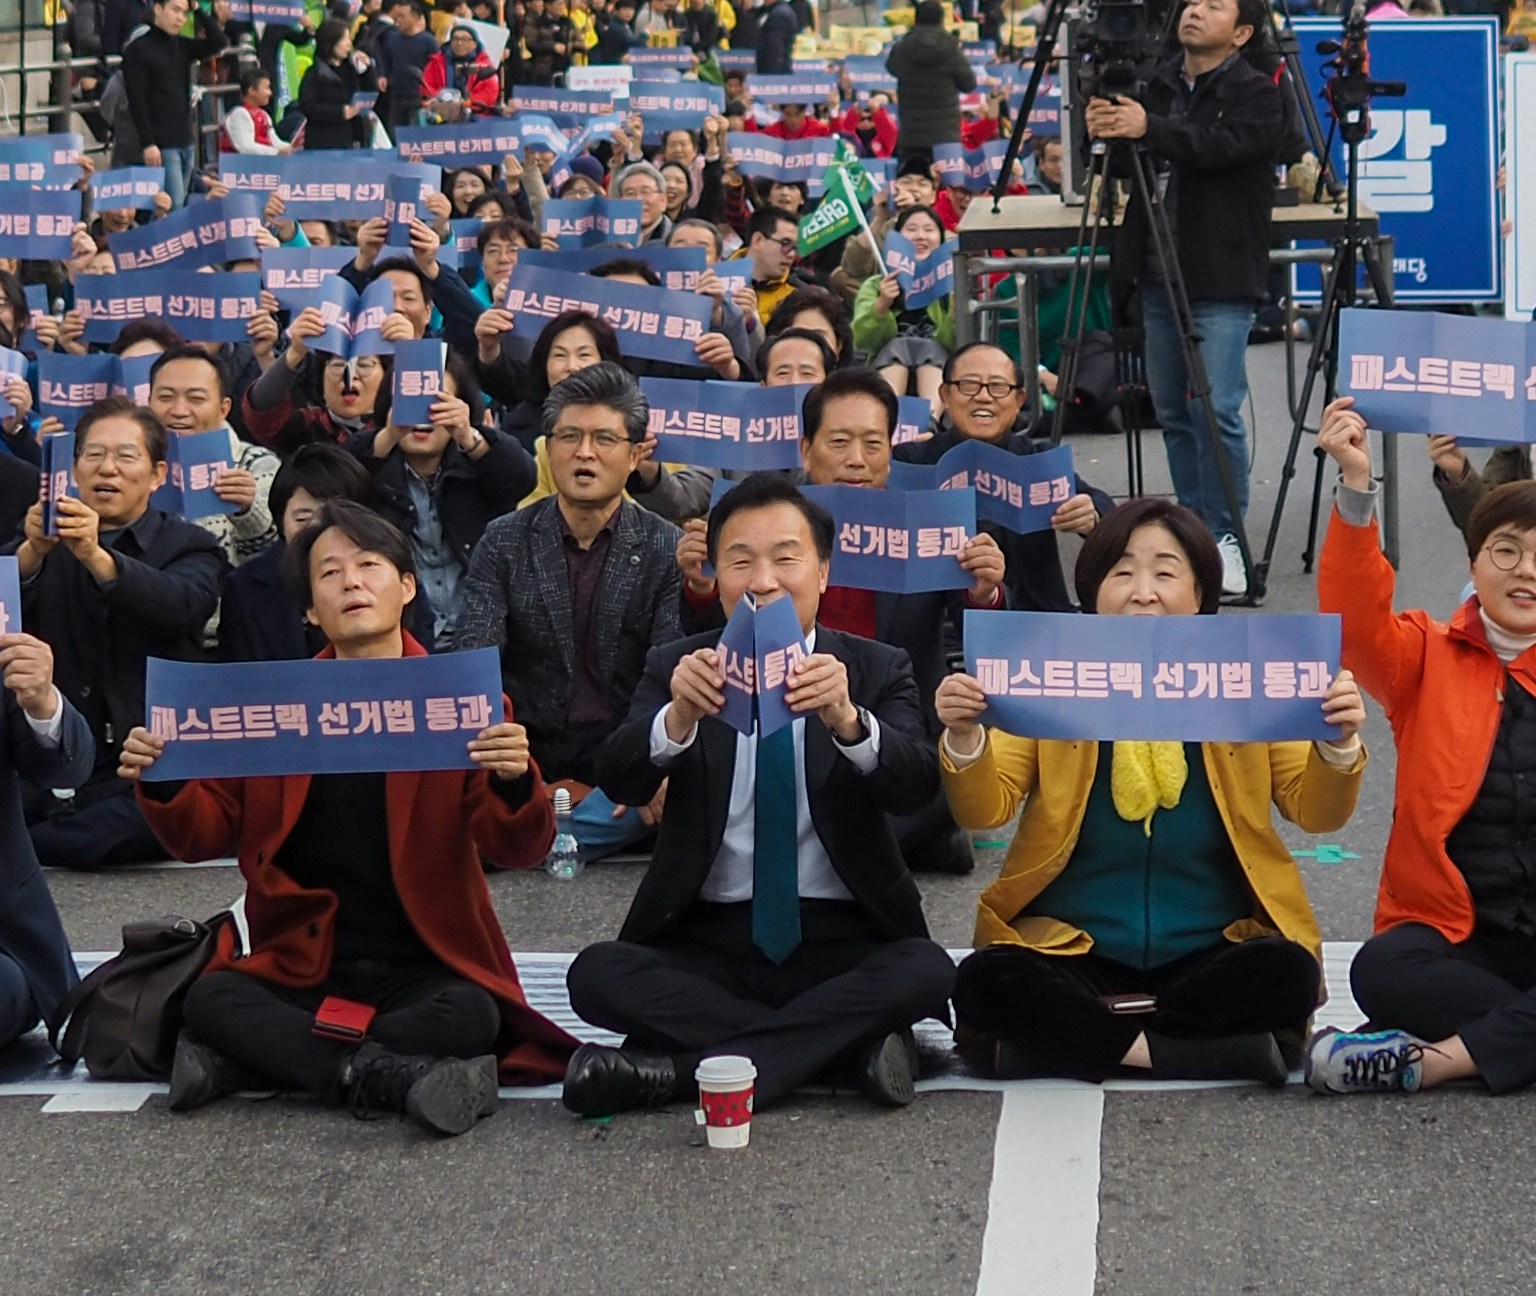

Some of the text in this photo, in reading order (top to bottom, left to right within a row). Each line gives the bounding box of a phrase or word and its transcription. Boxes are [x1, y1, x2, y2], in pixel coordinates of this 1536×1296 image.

[459, 138, 492, 154] 선거법
[15, 163, 45, 181] 통과
[35, 214, 76, 237] 통과
[198, 220, 227, 247] 선거법
[168, 295, 216, 320] 선거법
[221, 296, 257, 319] 통과
[603, 304, 660, 335] 선거법
[665, 315, 704, 343] 통과
[400, 370, 440, 396] 통과
[1350, 354, 1515, 400] 패스트트랙
[747, 414, 800, 443] 선거법
[975, 469, 1023, 509] 선거법
[1029, 475, 1071, 506] 통과
[839, 522, 970, 560] 선거법 통과
[975, 658, 1332, 699] 패스트트랙 선거법 통과
[150, 694, 493, 742] 패스트트랙 선거법 통과
